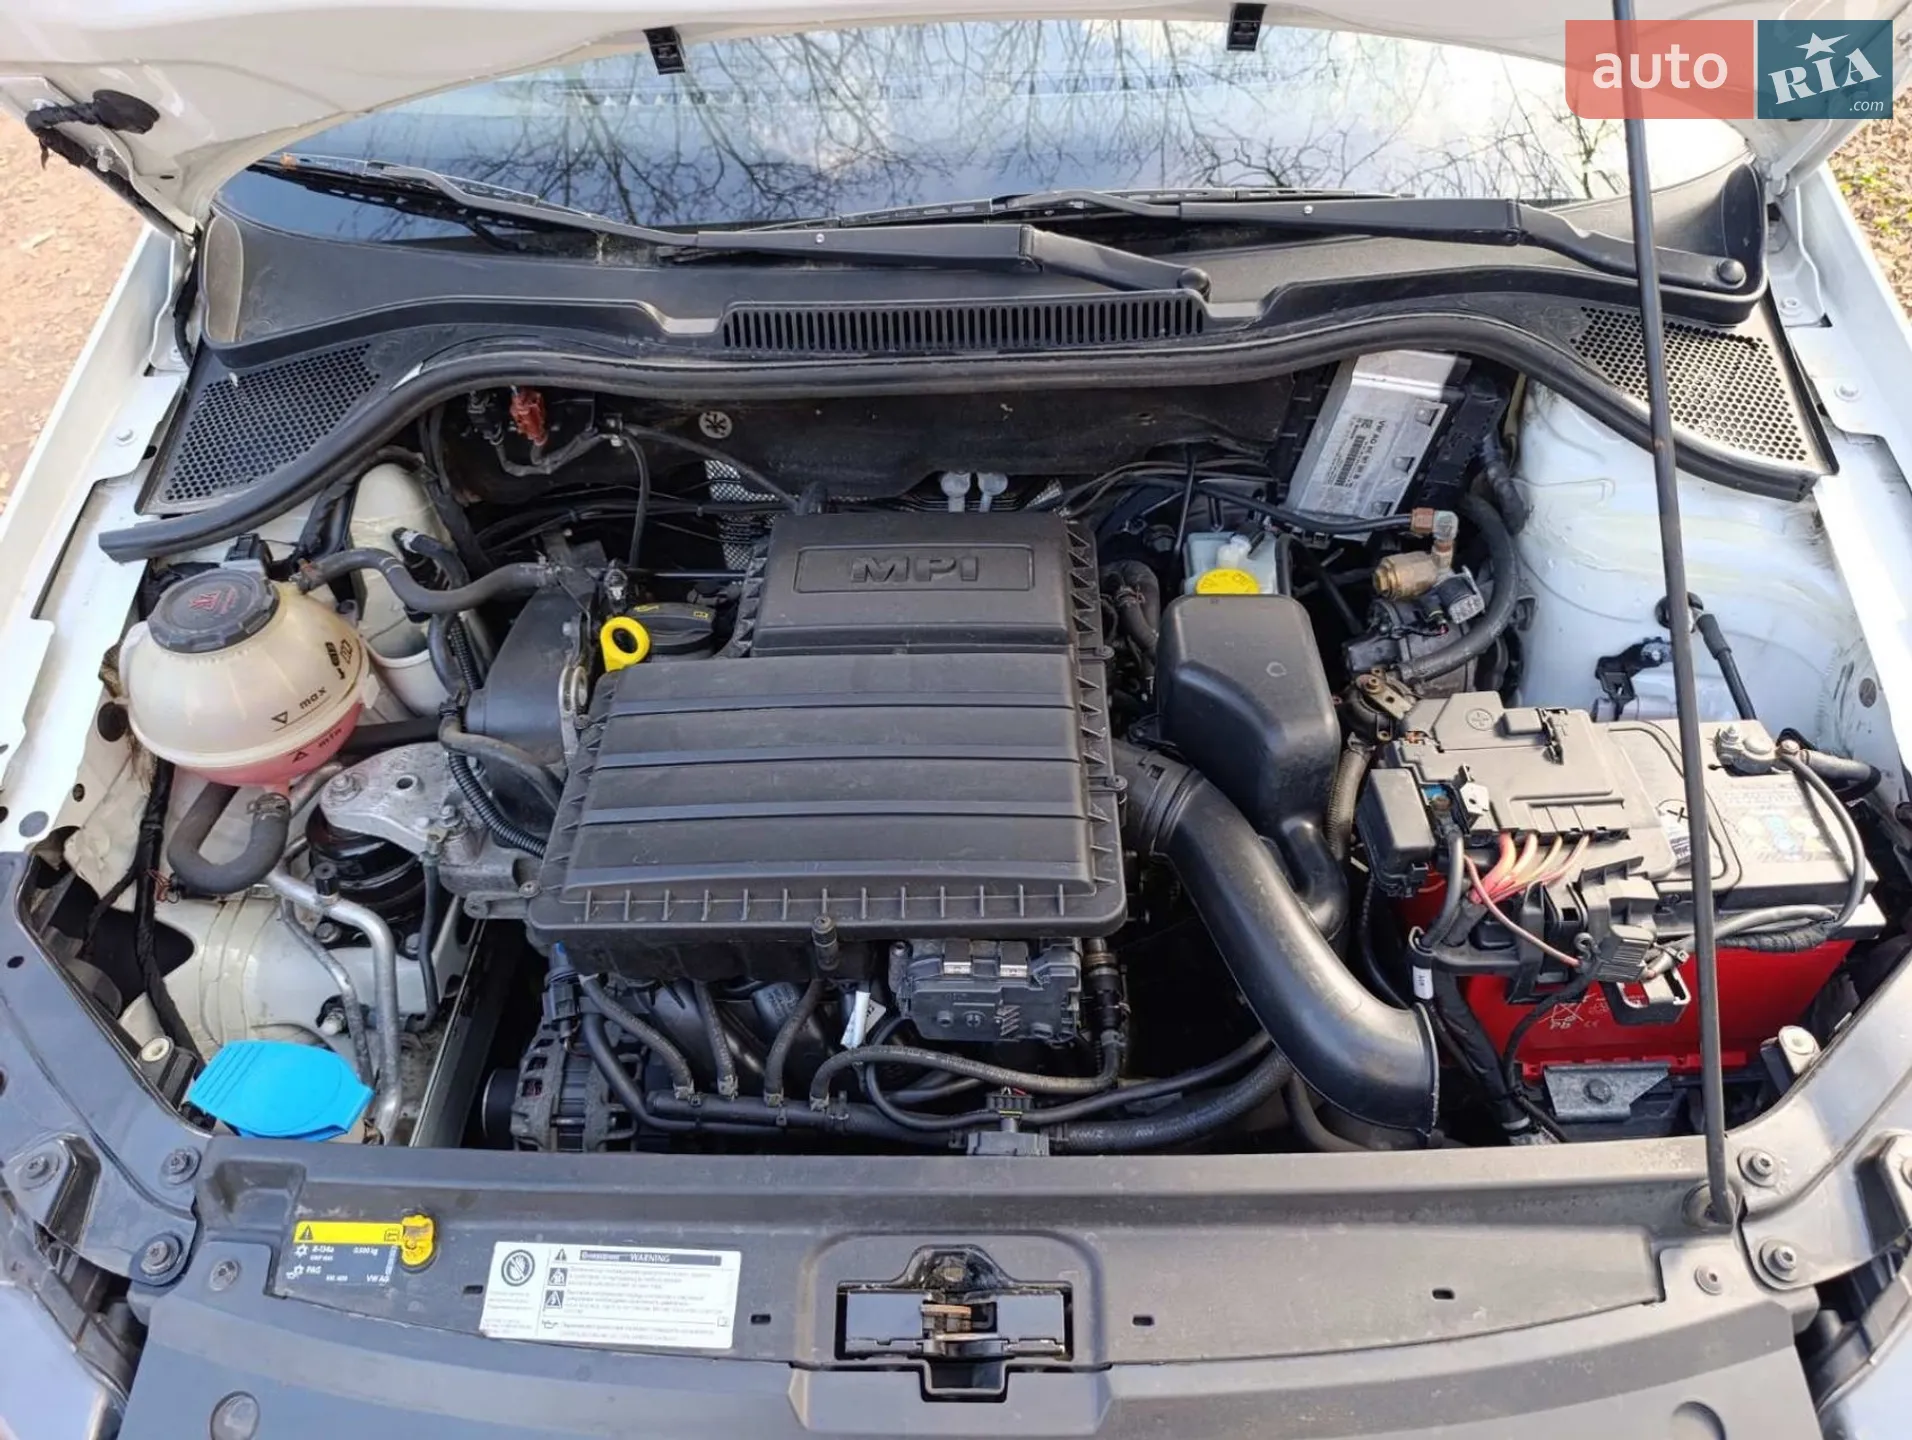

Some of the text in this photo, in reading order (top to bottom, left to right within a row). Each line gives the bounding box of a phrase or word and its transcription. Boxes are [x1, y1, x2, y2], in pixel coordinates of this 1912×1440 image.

[851, 556, 980, 583] MPI
[299, 686, 327, 710] max
[318, 728, 342, 748] min
[630, 1252, 671, 1264] WARNING
